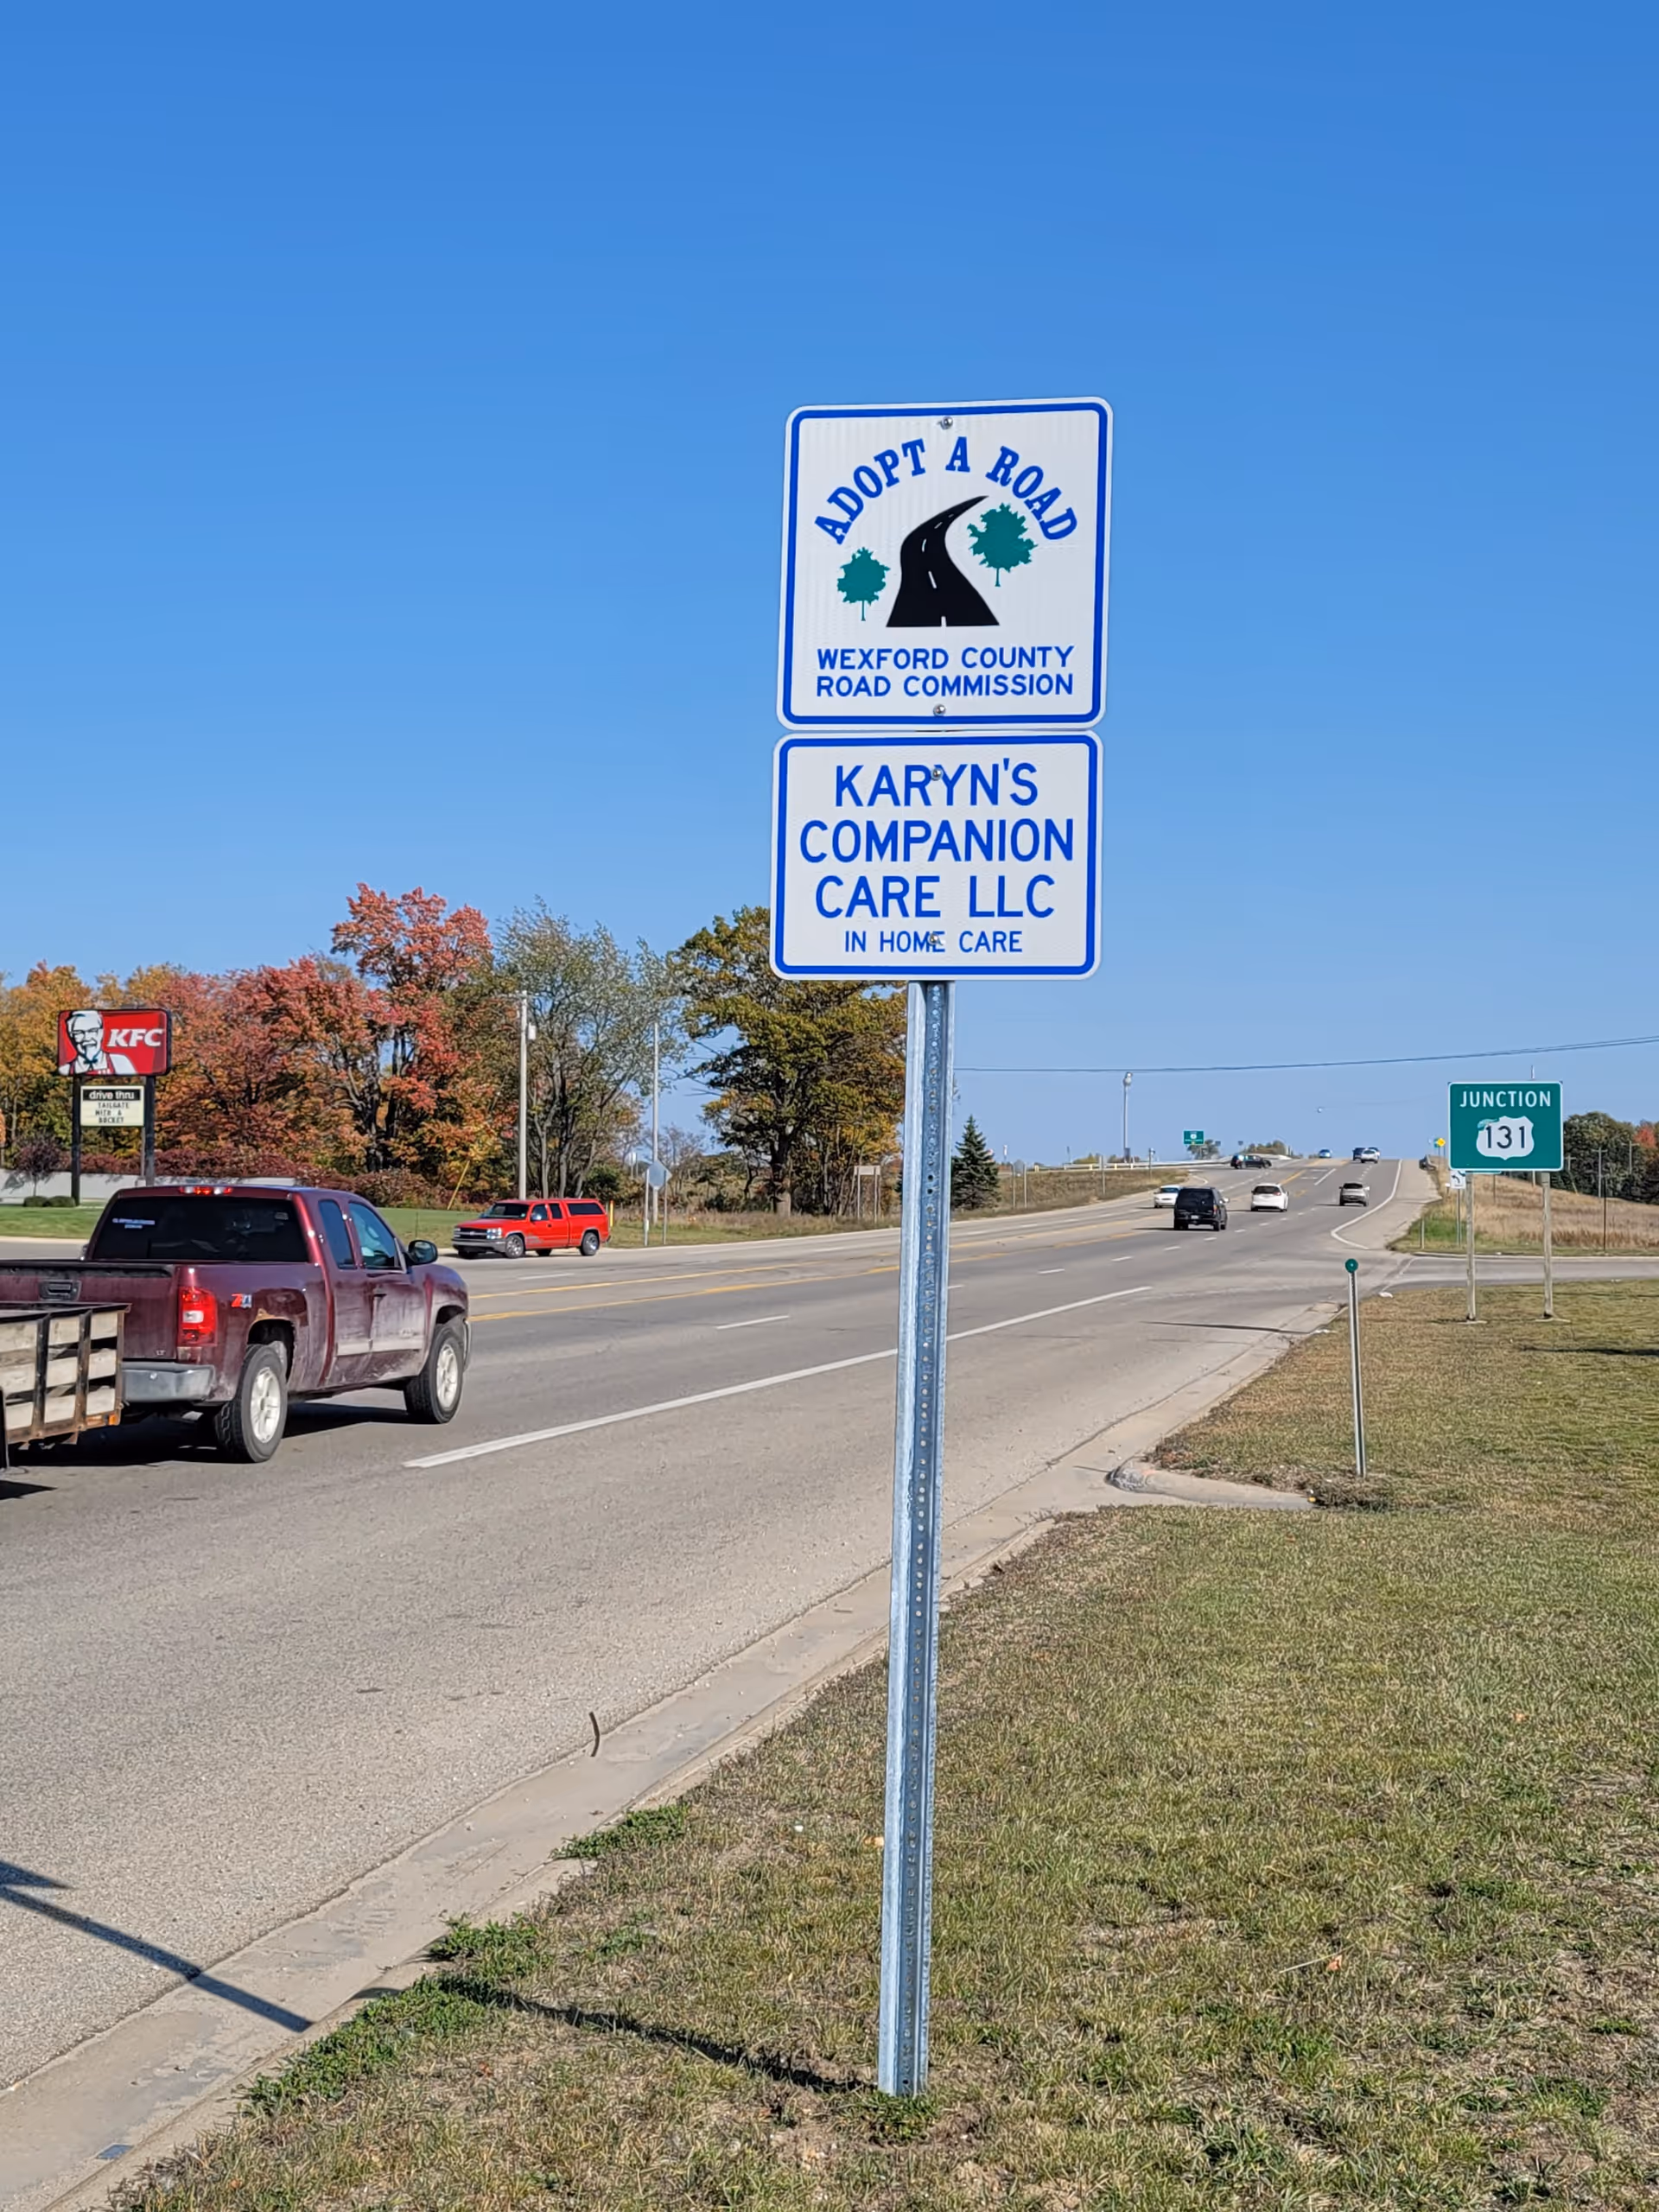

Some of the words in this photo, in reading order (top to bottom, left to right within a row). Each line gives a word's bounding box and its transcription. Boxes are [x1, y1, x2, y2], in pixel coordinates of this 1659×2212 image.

[815, 438, 926, 545] ADOPT
[945, 436, 970, 474] A
[986, 446, 1078, 541] ROAD
[817, 647, 950, 671] WEXFORD
[961, 645, 1075, 670] COUNTY
[817, 675, 892, 697] ROAD
[903, 673, 1074, 697] COMMISSION
[835, 757, 1039, 808] KARYN'S
[799, 817, 1074, 864] COMPANION
[815, 874, 942, 919] CARE
[969, 874, 1056, 919] LLC
[844, 931, 867, 953] IN
[880, 930, 946, 953] HOME
[958, 930, 1023, 953] CARE
[107, 1028, 163, 1047] KFC
[89, 1090, 113, 1100] drive
[115, 1090, 135, 1100] thru
[1459, 1090, 1551, 1108] JUNCTION
[1485, 1125, 1525, 1149] 131
